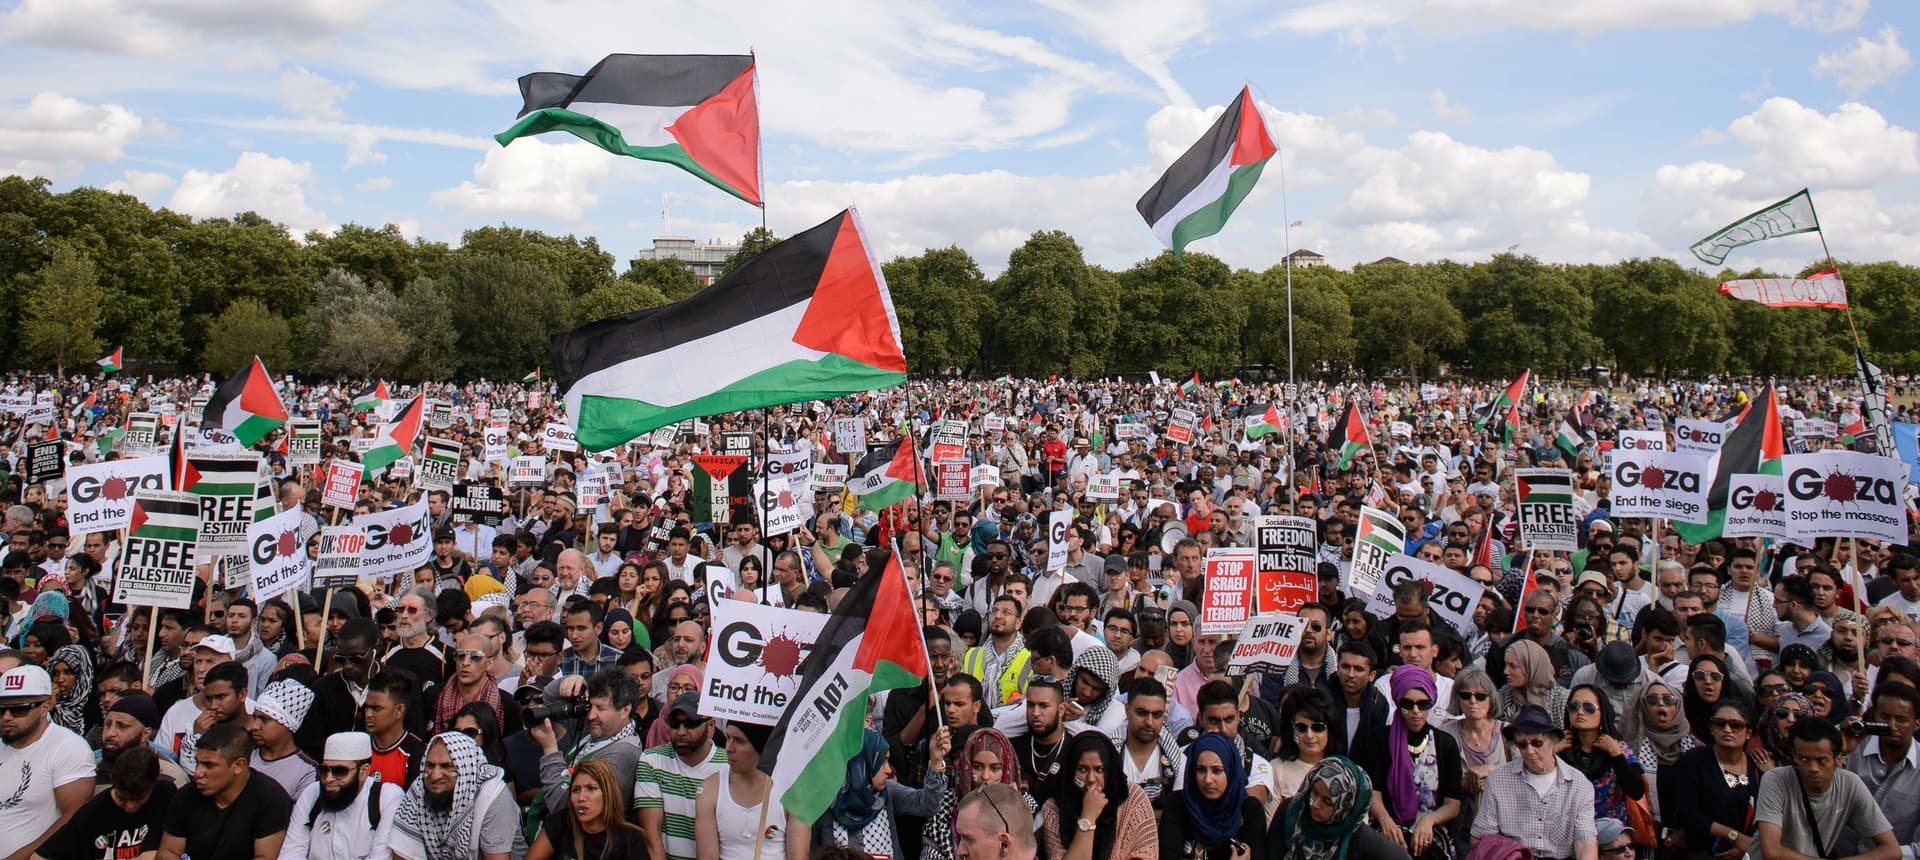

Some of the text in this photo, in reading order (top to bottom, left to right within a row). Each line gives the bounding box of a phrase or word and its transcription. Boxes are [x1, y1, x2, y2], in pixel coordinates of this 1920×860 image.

[27, 408, 50, 416] Gza
[126, 432, 152, 443] FREE
[204, 428, 234, 444] Gza
[546, 428, 576, 440] Gza
[726, 436, 750, 448] END
[1678, 426, 1720, 444] Gza
[290, 440, 318, 449] FREE
[1622, 436, 1662, 450] Gza
[34, 446, 56, 457] END
[336, 468, 355, 476] STOP
[422, 460, 456, 478] FREE
[768, 458, 808, 474] Gza
[942, 472, 966, 480] ISRAELI
[1616, 461, 1700, 494] Gza
[72, 473, 162, 503] Gza
[467, 486, 490, 498] FREE
[1788, 468, 1898, 506] Gza
[200, 496, 254, 522] REE
[454, 497, 502, 512] PALESTINE
[1616, 496, 1700, 514] End the siege
[74, 508, 126, 524] End the
[768, 514, 796, 527] nd the
[1520, 504, 1574, 524] FREE
[1728, 516, 1786, 527] Stop the mass
[1791, 508, 1899, 526] Stop the massacre
[202, 522, 250, 534] ESTINE
[365, 510, 428, 550] Gza
[650, 526, 670, 540] PALES
[1522, 524, 1575, 534] PALESTINE
[1262, 529, 1314, 548] FREEDOM
[124, 538, 196, 570] FREE
[362, 556, 384, 568] Stop
[388, 552, 402, 561] the
[1216, 562, 1244, 576] STOP
[1260, 554, 1316, 574] PALESTINE
[1354, 561, 1381, 580] PALES
[120, 566, 192, 584] PALESTINE
[256, 573, 278, 590] End
[280, 564, 298, 580] the
[1210, 576, 1247, 590] ISRAELI
[1212, 592, 1242, 606] STATE
[1384, 566, 1470, 616] Gza
[1207, 608, 1245, 622] TERROR
[1252, 622, 1294, 639] END THE
[1236, 640, 1296, 658] OCCUPATION
[708, 678, 786, 708] End the
[714, 705, 778, 720] Stop the War Coalition
